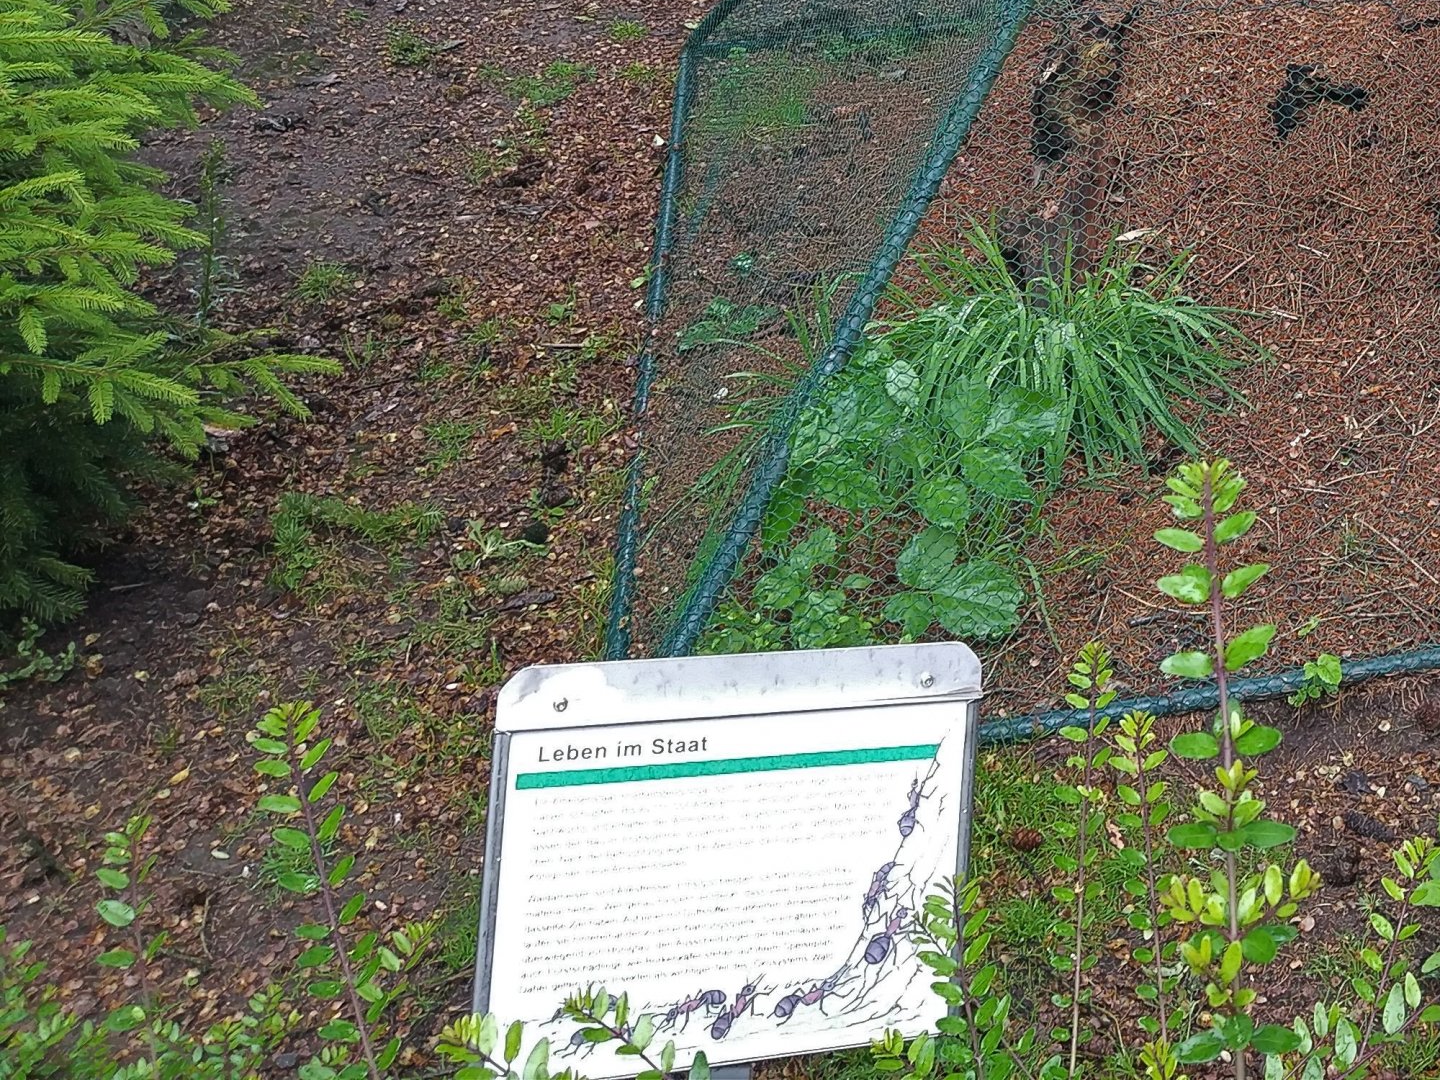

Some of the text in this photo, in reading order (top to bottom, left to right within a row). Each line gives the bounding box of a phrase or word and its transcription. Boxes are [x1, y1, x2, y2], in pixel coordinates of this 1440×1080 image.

[538, 736, 708, 762] Leben im Staat
